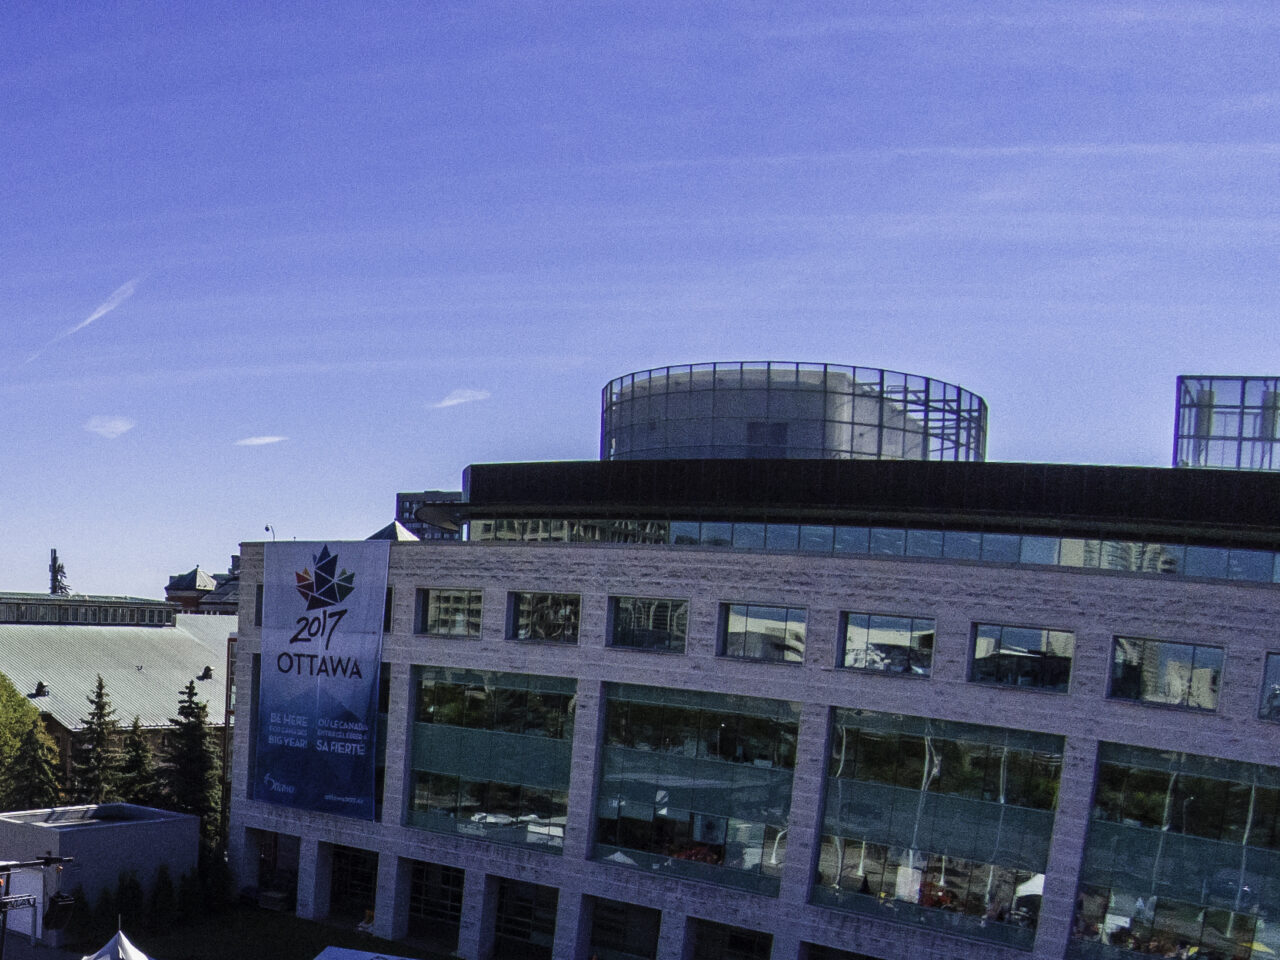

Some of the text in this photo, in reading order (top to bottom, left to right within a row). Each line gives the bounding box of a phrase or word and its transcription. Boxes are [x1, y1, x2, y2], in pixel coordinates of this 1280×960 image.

[290, 609, 348, 650] 2017
[277, 652, 362, 679] OTTAWA
[283, 713, 309, 727] HERE
[316, 739, 329, 752] SA
